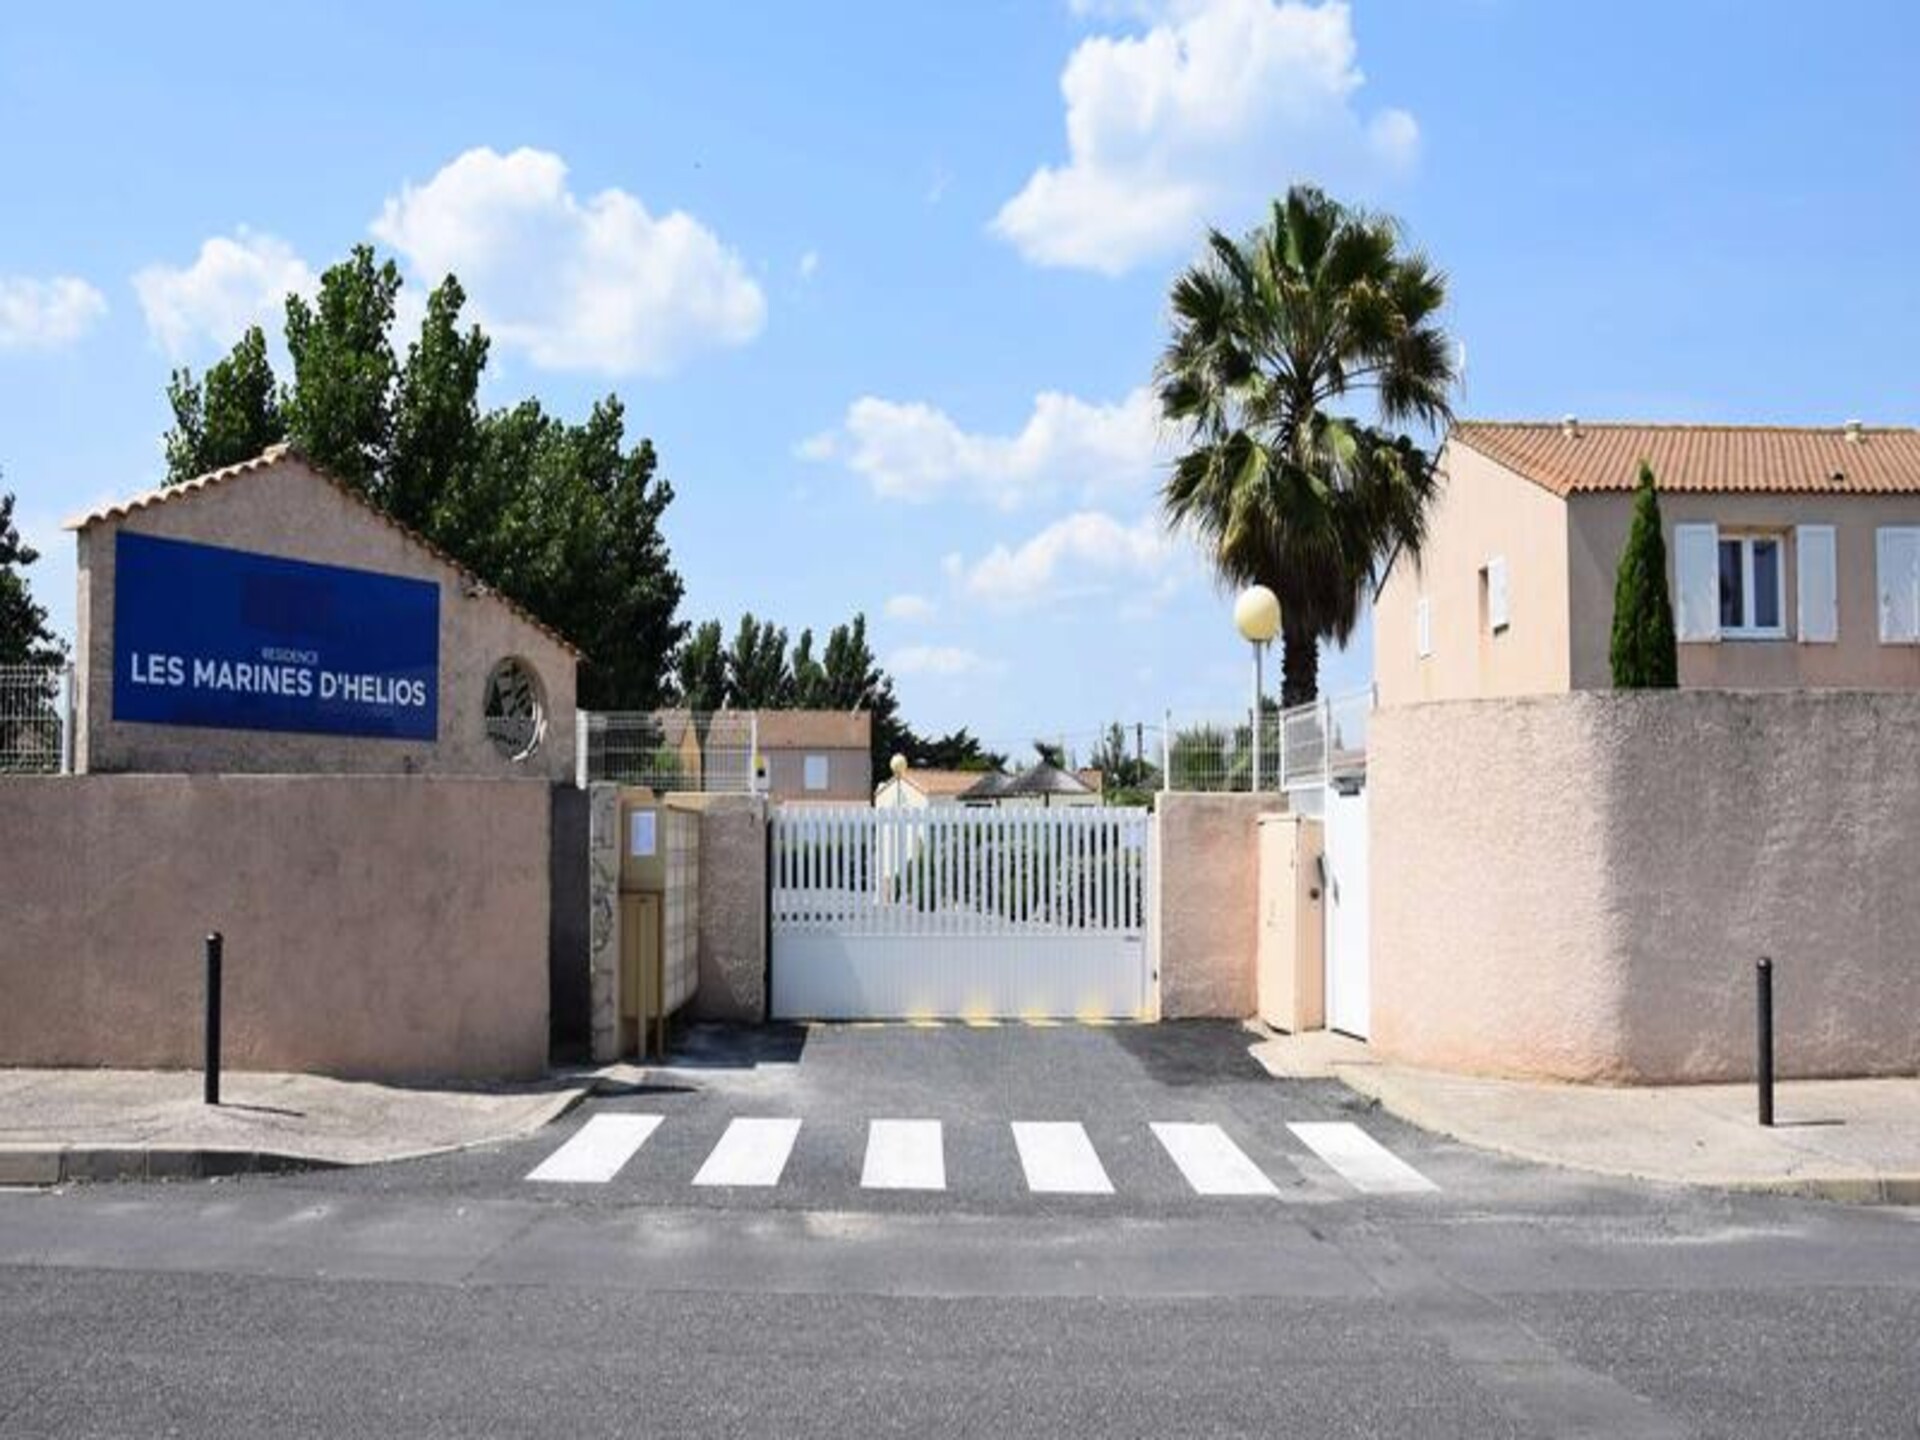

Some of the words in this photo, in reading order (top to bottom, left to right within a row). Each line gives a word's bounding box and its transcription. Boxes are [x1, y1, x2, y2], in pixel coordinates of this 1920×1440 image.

[131, 652, 185, 686] LES
[193, 658, 313, 696] MARINES
[320, 671, 426, 706] D'HELIOS
